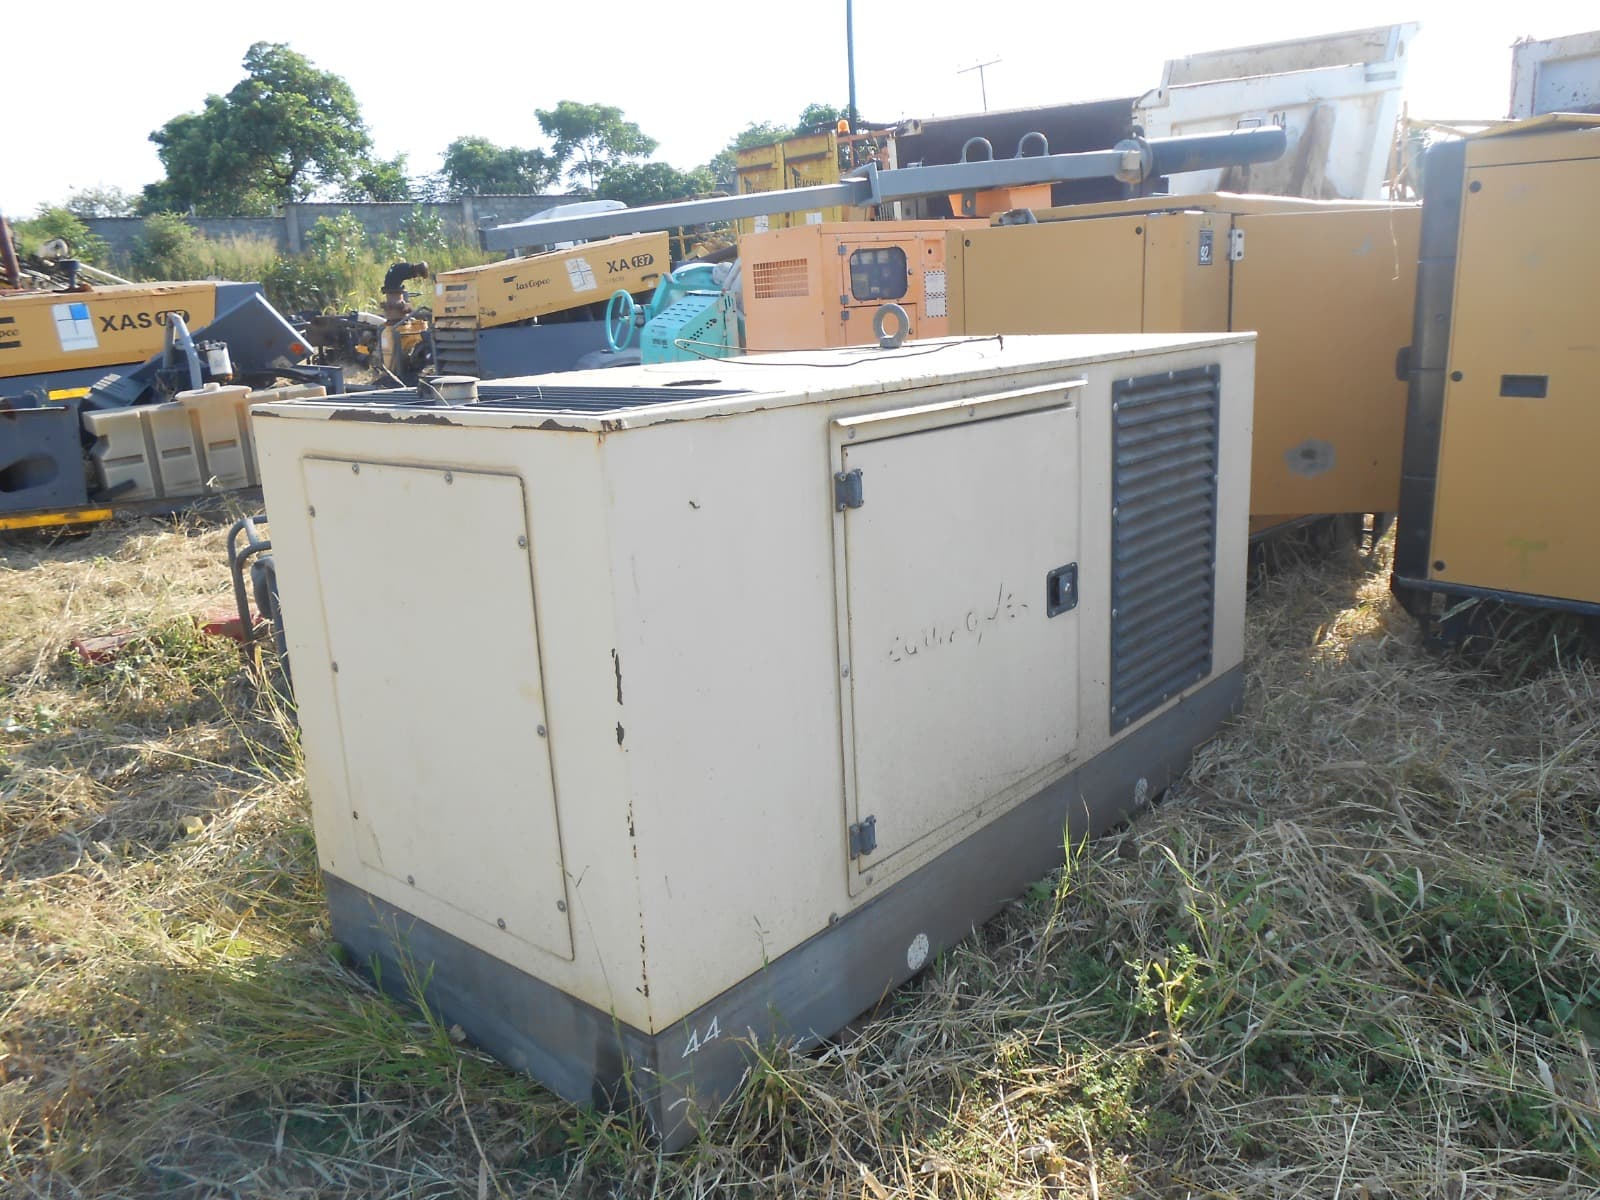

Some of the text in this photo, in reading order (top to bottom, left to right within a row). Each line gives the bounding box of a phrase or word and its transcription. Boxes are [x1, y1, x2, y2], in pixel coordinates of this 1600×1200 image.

[606, 254, 652, 274] XA 137
[99, 312, 152, 333] XAS
[681, 1015, 722, 1058] 44
